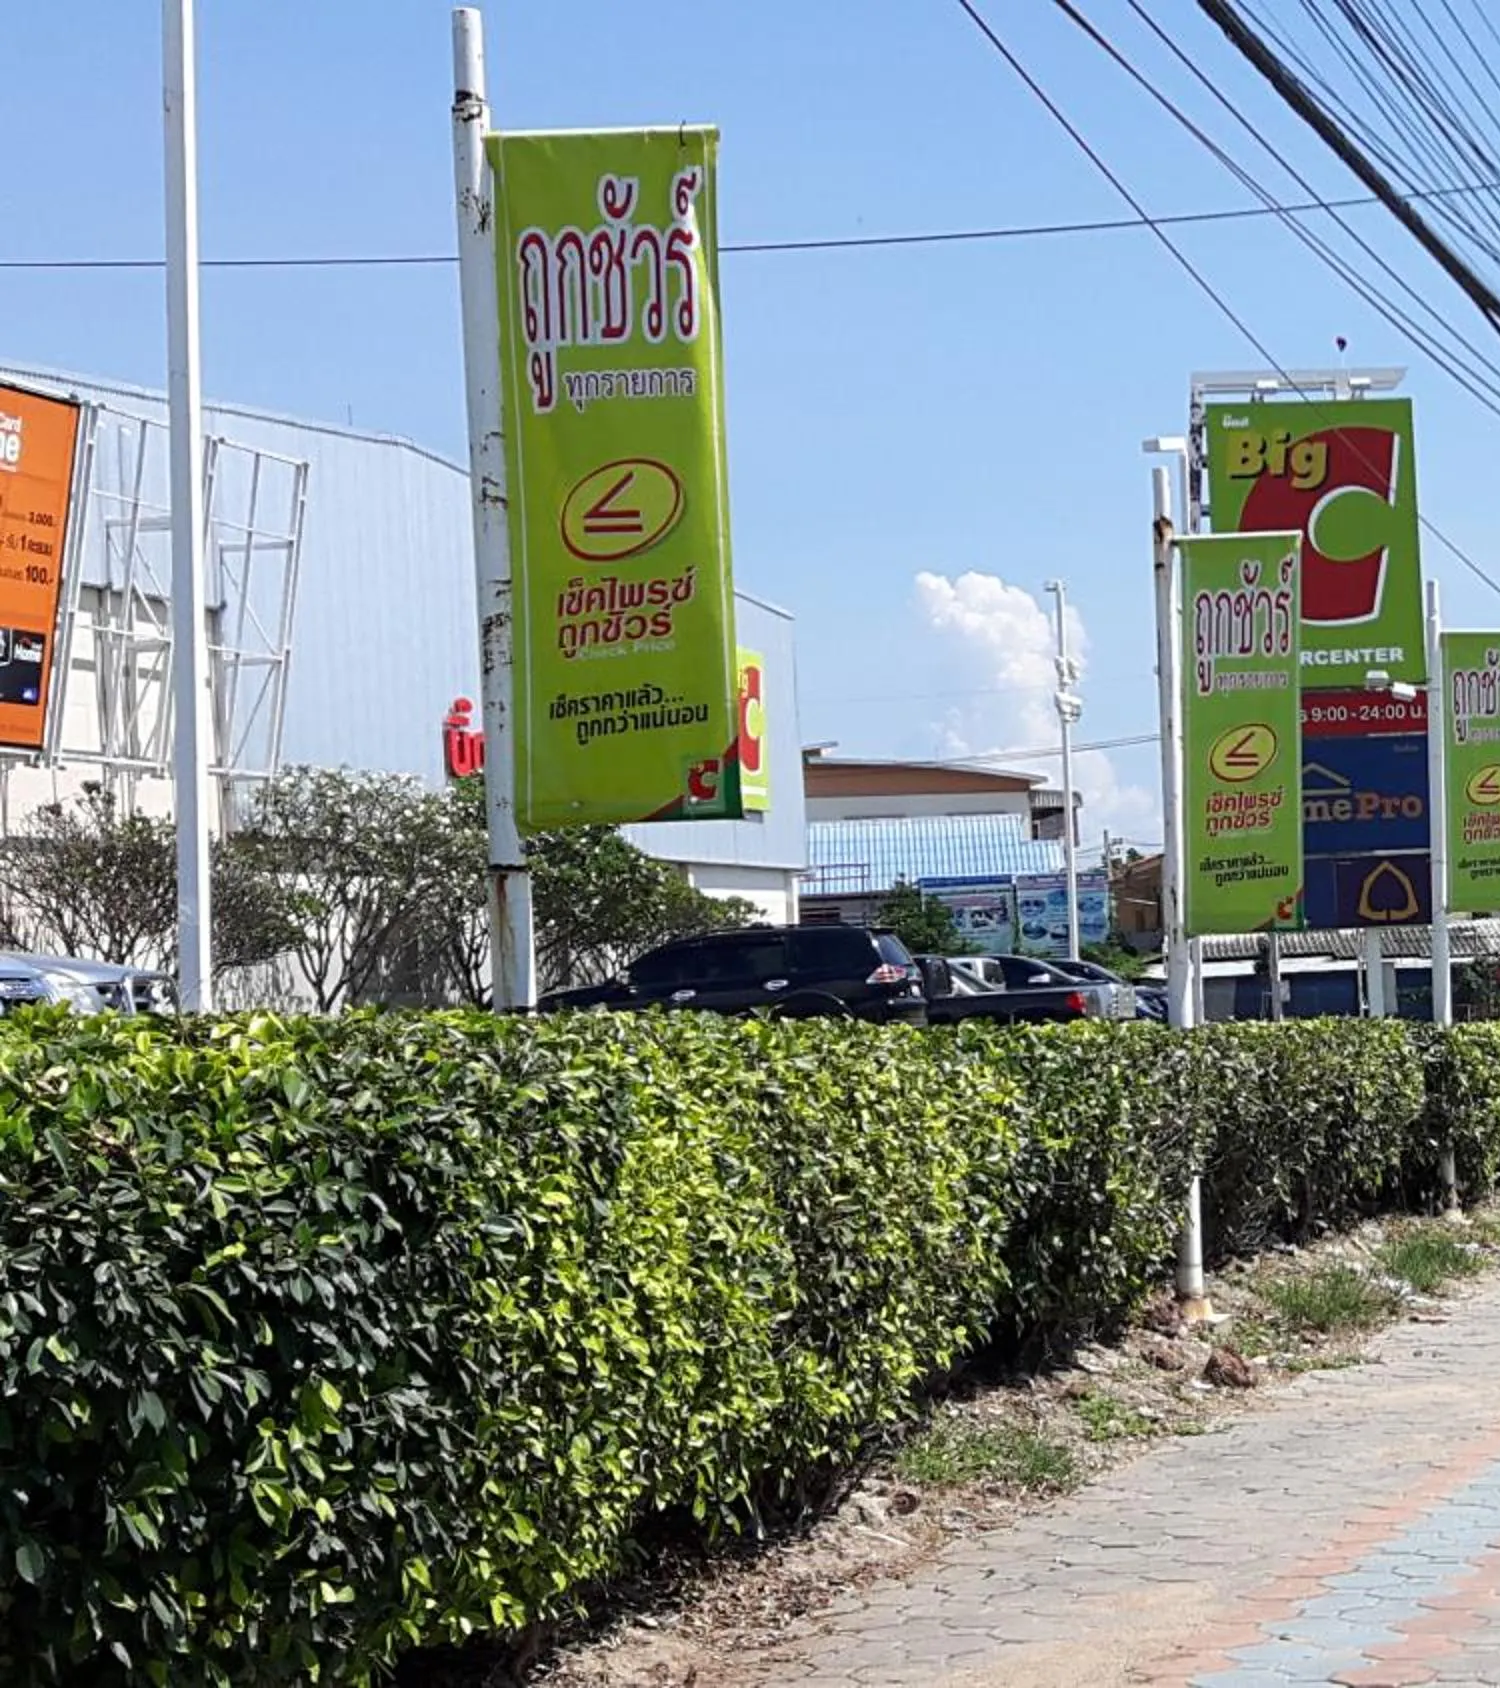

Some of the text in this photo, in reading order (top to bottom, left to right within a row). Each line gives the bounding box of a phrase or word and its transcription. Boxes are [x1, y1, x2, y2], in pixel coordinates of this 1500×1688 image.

[519, 169, 699, 409] ถูกชัวร์
[564, 369, 696, 409] ทุกรายการ
[1226, 428, 1328, 489] Big
[1301, 648, 1404, 665] RCENTER
[1311, 706, 1348, 722] 9:00
[1359, 704, 1406, 721] 24:00
[1303, 792, 1423, 822] mePro
